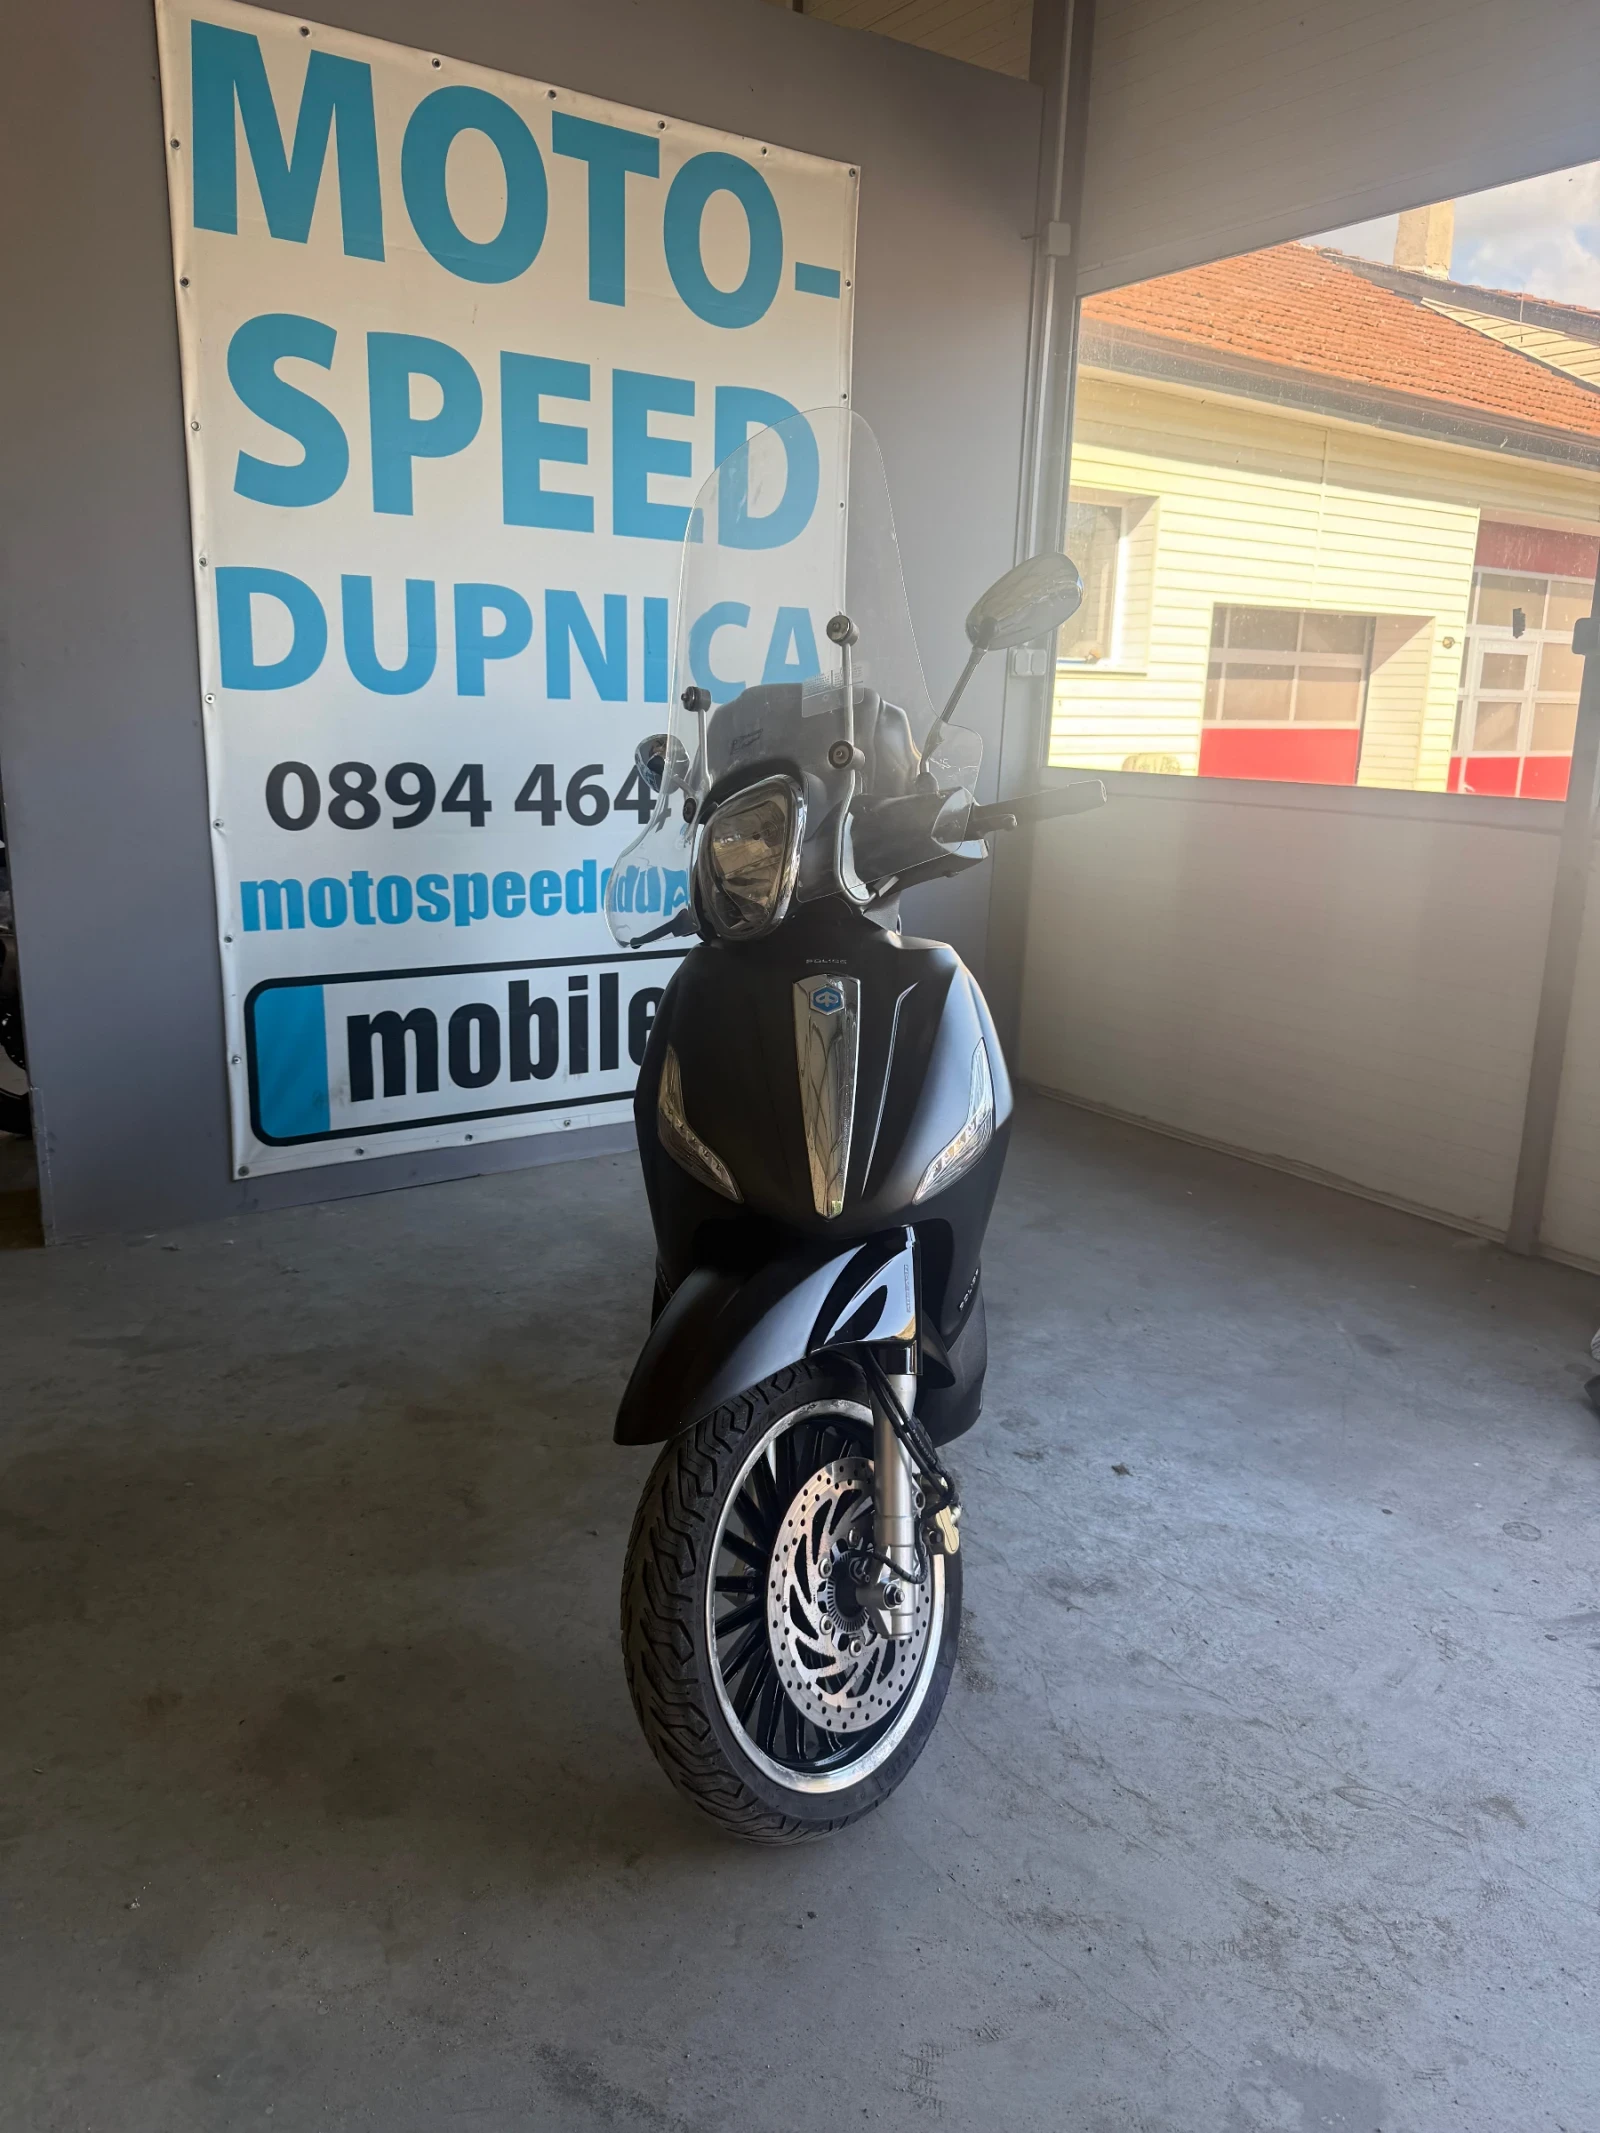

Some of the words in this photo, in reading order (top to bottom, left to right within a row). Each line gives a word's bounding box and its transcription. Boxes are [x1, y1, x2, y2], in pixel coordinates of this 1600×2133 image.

[190, 18, 841, 330] MOTO-
[226, 312, 820, 551] SPEED
[215, 566, 824, 704] DUPNICA
[265, 760, 492, 831] 0894
[513, 762, 660, 827] 464
[346, 971, 665, 1103] mobile
